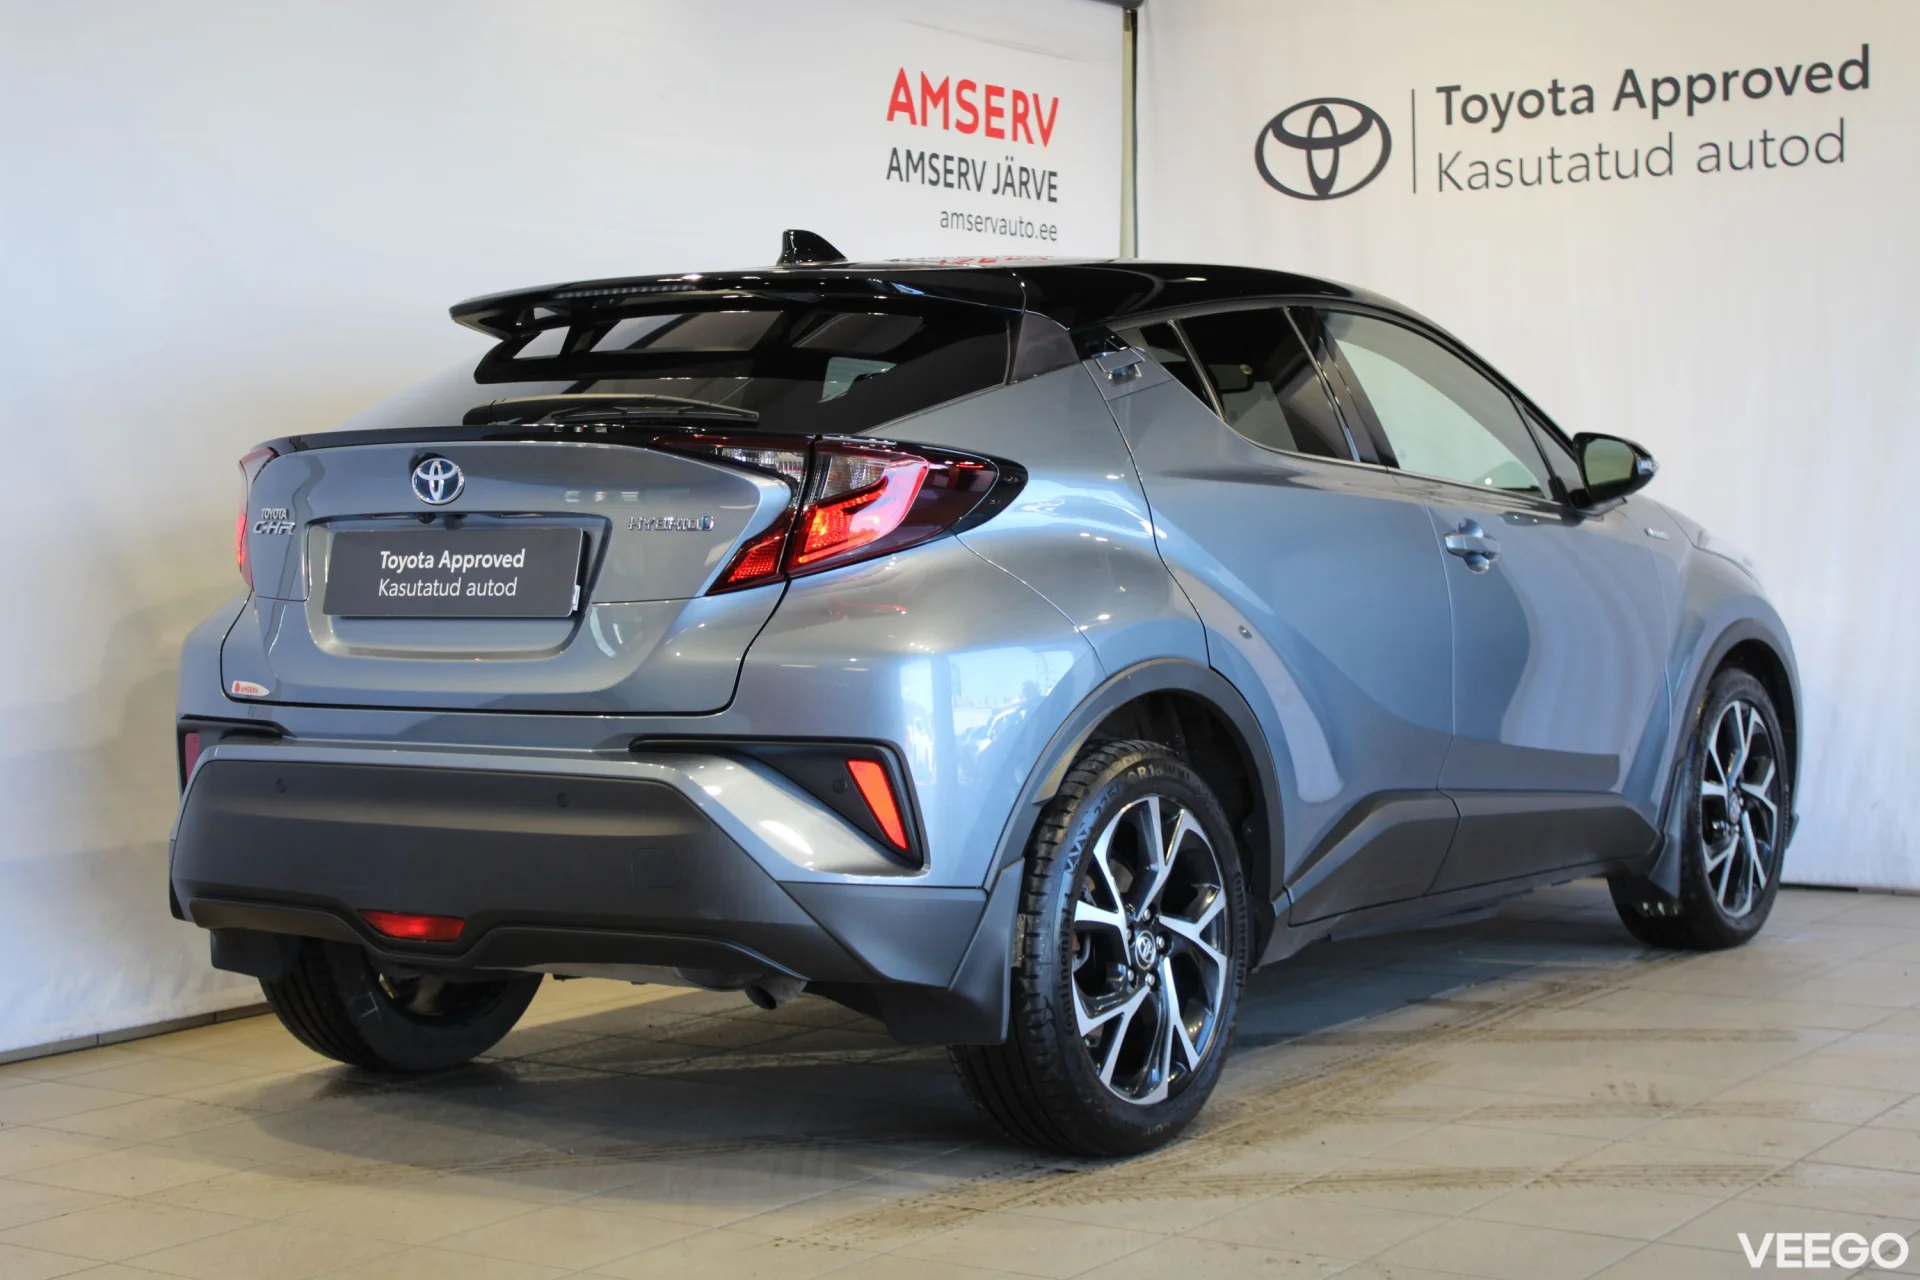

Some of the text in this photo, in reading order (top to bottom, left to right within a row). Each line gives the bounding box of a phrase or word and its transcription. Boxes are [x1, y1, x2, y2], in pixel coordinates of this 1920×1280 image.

[1436, 44, 1870, 133] Toyota Approved
[886, 67, 1059, 148] AMSERV
[1438, 117, 1845, 192] Kasutatud autod
[886, 147, 1058, 203] AMSERV JÄRVE
[939, 210, 1058, 242] amservauto.ee
[262, 508, 287, 520] TOYOTA
[628, 516, 702, 530] HYBRID
[380, 548, 526, 573] Toyota Approved
[378, 577, 518, 597] Kasutatud autod
